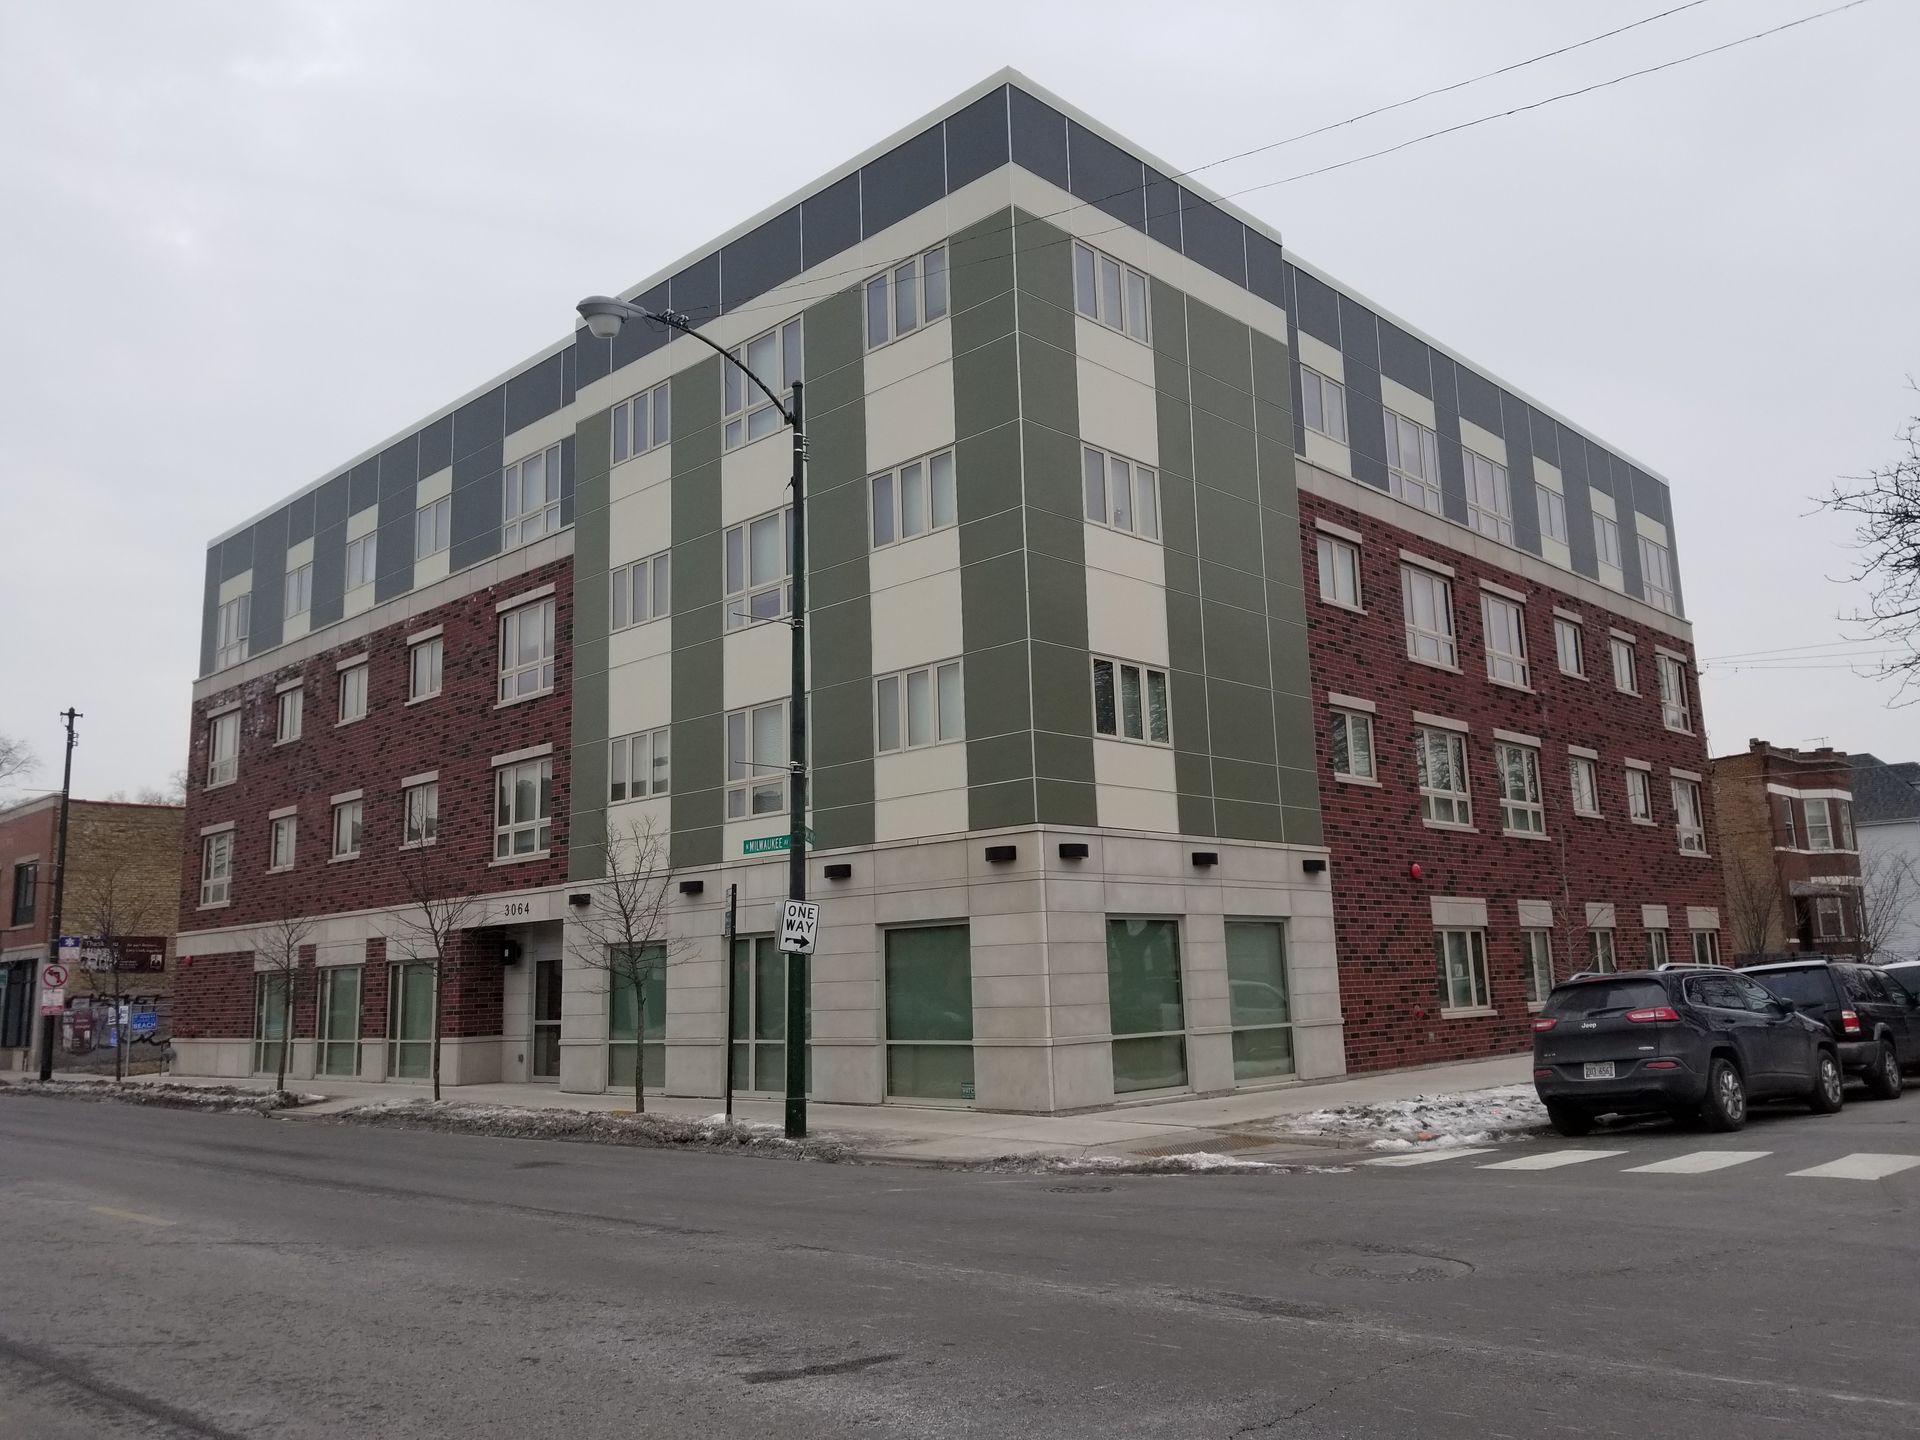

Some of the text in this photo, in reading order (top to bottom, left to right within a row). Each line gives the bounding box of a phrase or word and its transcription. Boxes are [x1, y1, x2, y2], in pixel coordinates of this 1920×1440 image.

[749, 837, 783, 852] MILWAUKEE
[504, 902, 530, 917] 3064
[788, 905, 815, 920] ONE
[786, 918, 814, 934] WAY
